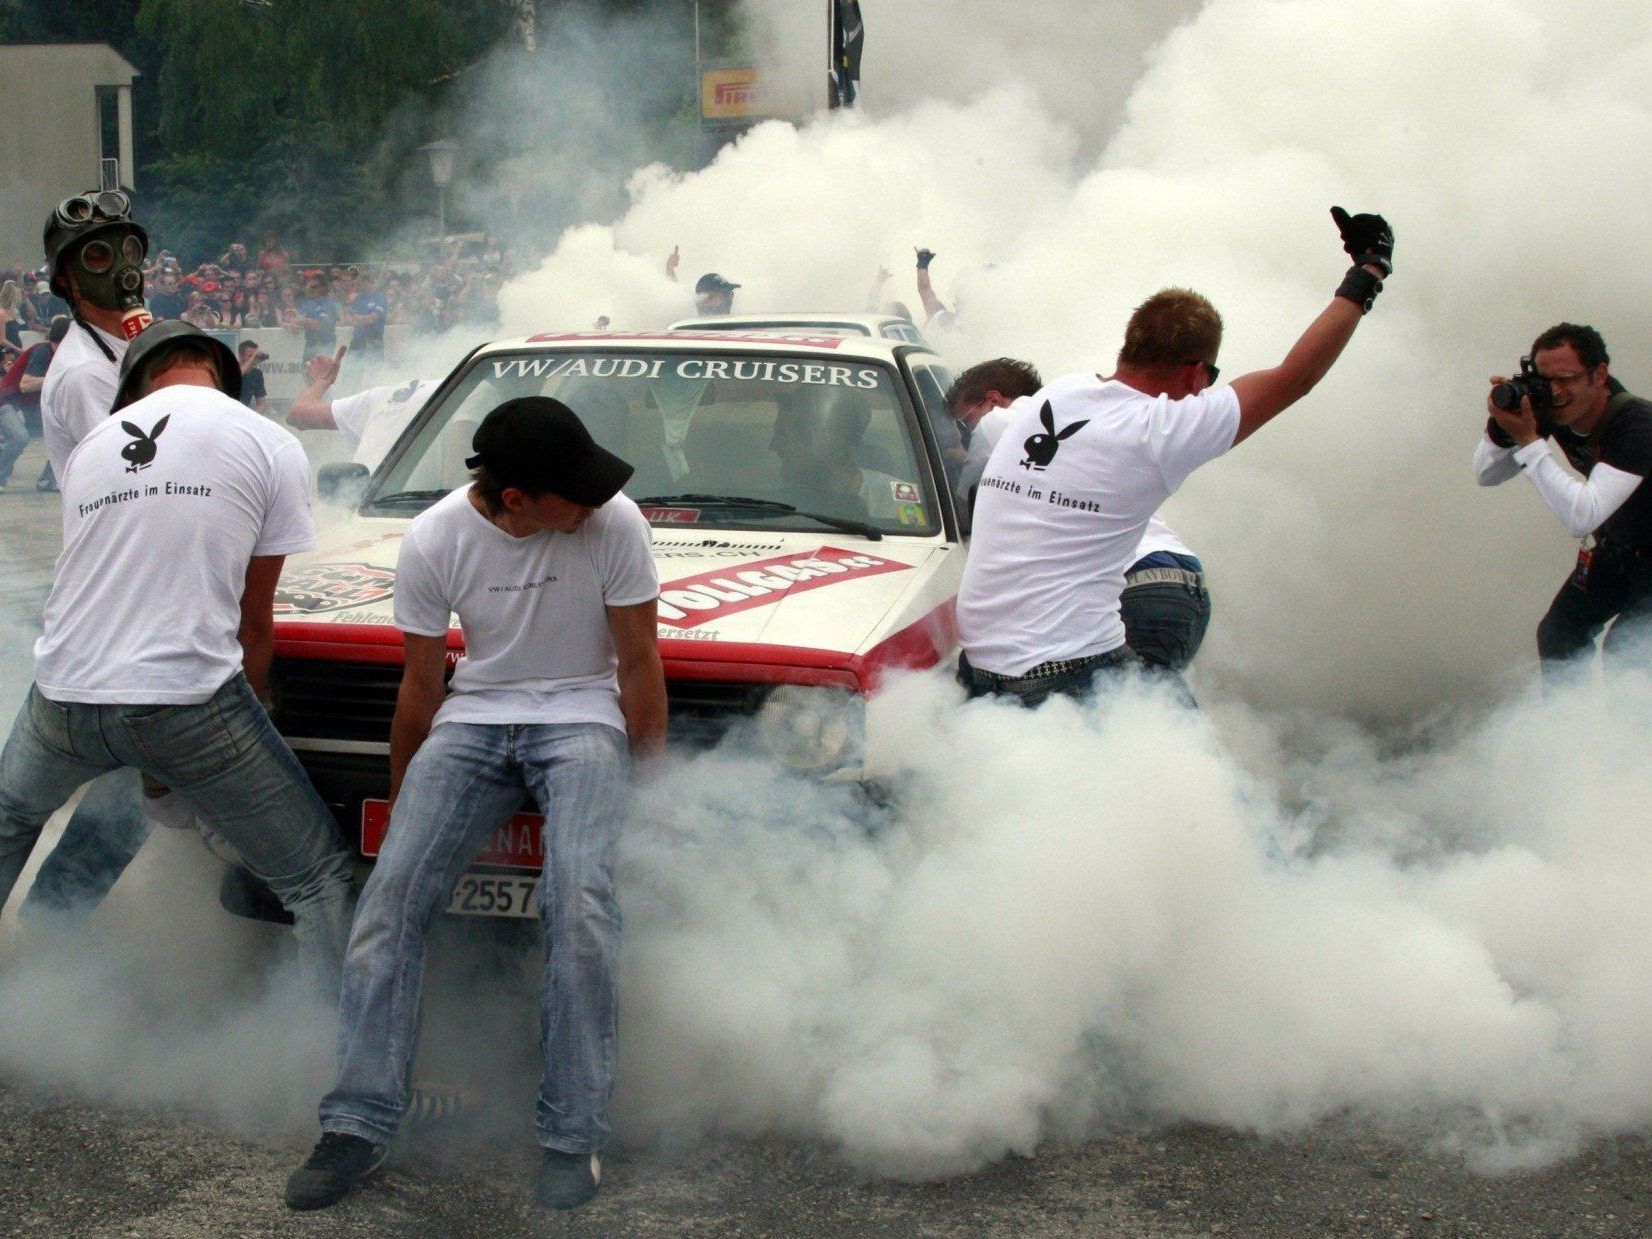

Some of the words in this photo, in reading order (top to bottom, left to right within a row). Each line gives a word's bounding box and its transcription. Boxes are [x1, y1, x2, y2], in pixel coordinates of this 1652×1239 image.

[492, 358, 664, 380] VW/AUDI
[676, 359, 880, 390] CRUISERS
[79, 489, 140, 517] Frauenärzte
[144, 484, 159, 497] im
[165, 481, 212, 497] Einsatz
[980, 476, 1022, 494] uenärzte
[1027, 485, 1042, 500] im
[1048, 490, 1101, 513] Einsatz
